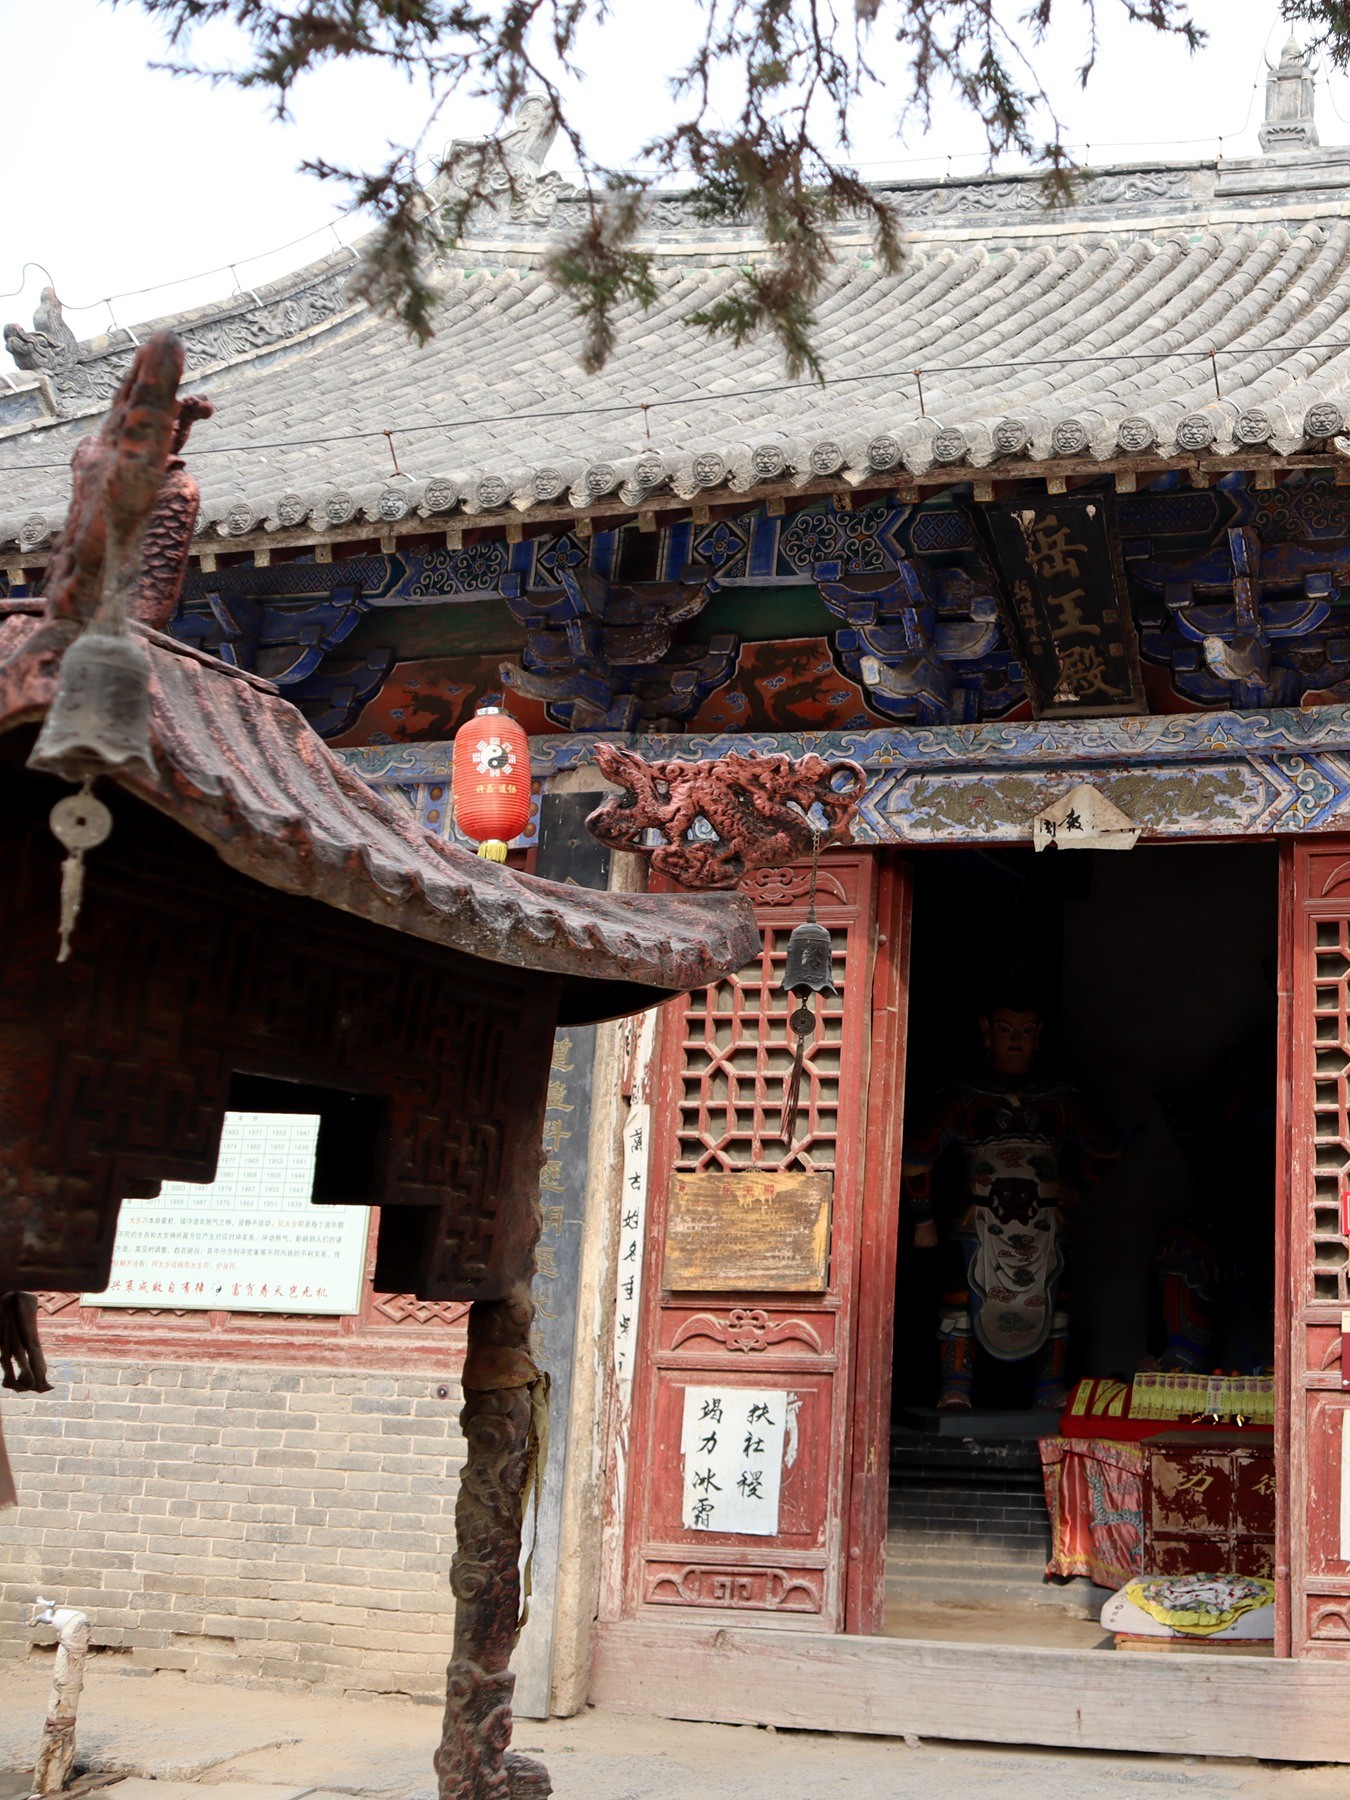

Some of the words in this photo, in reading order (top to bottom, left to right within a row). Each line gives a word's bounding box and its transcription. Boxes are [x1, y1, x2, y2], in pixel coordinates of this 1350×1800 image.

[1025, 514, 1124, 697] 岳王殿
[736, 1403, 776, 1500] 扶社稷
